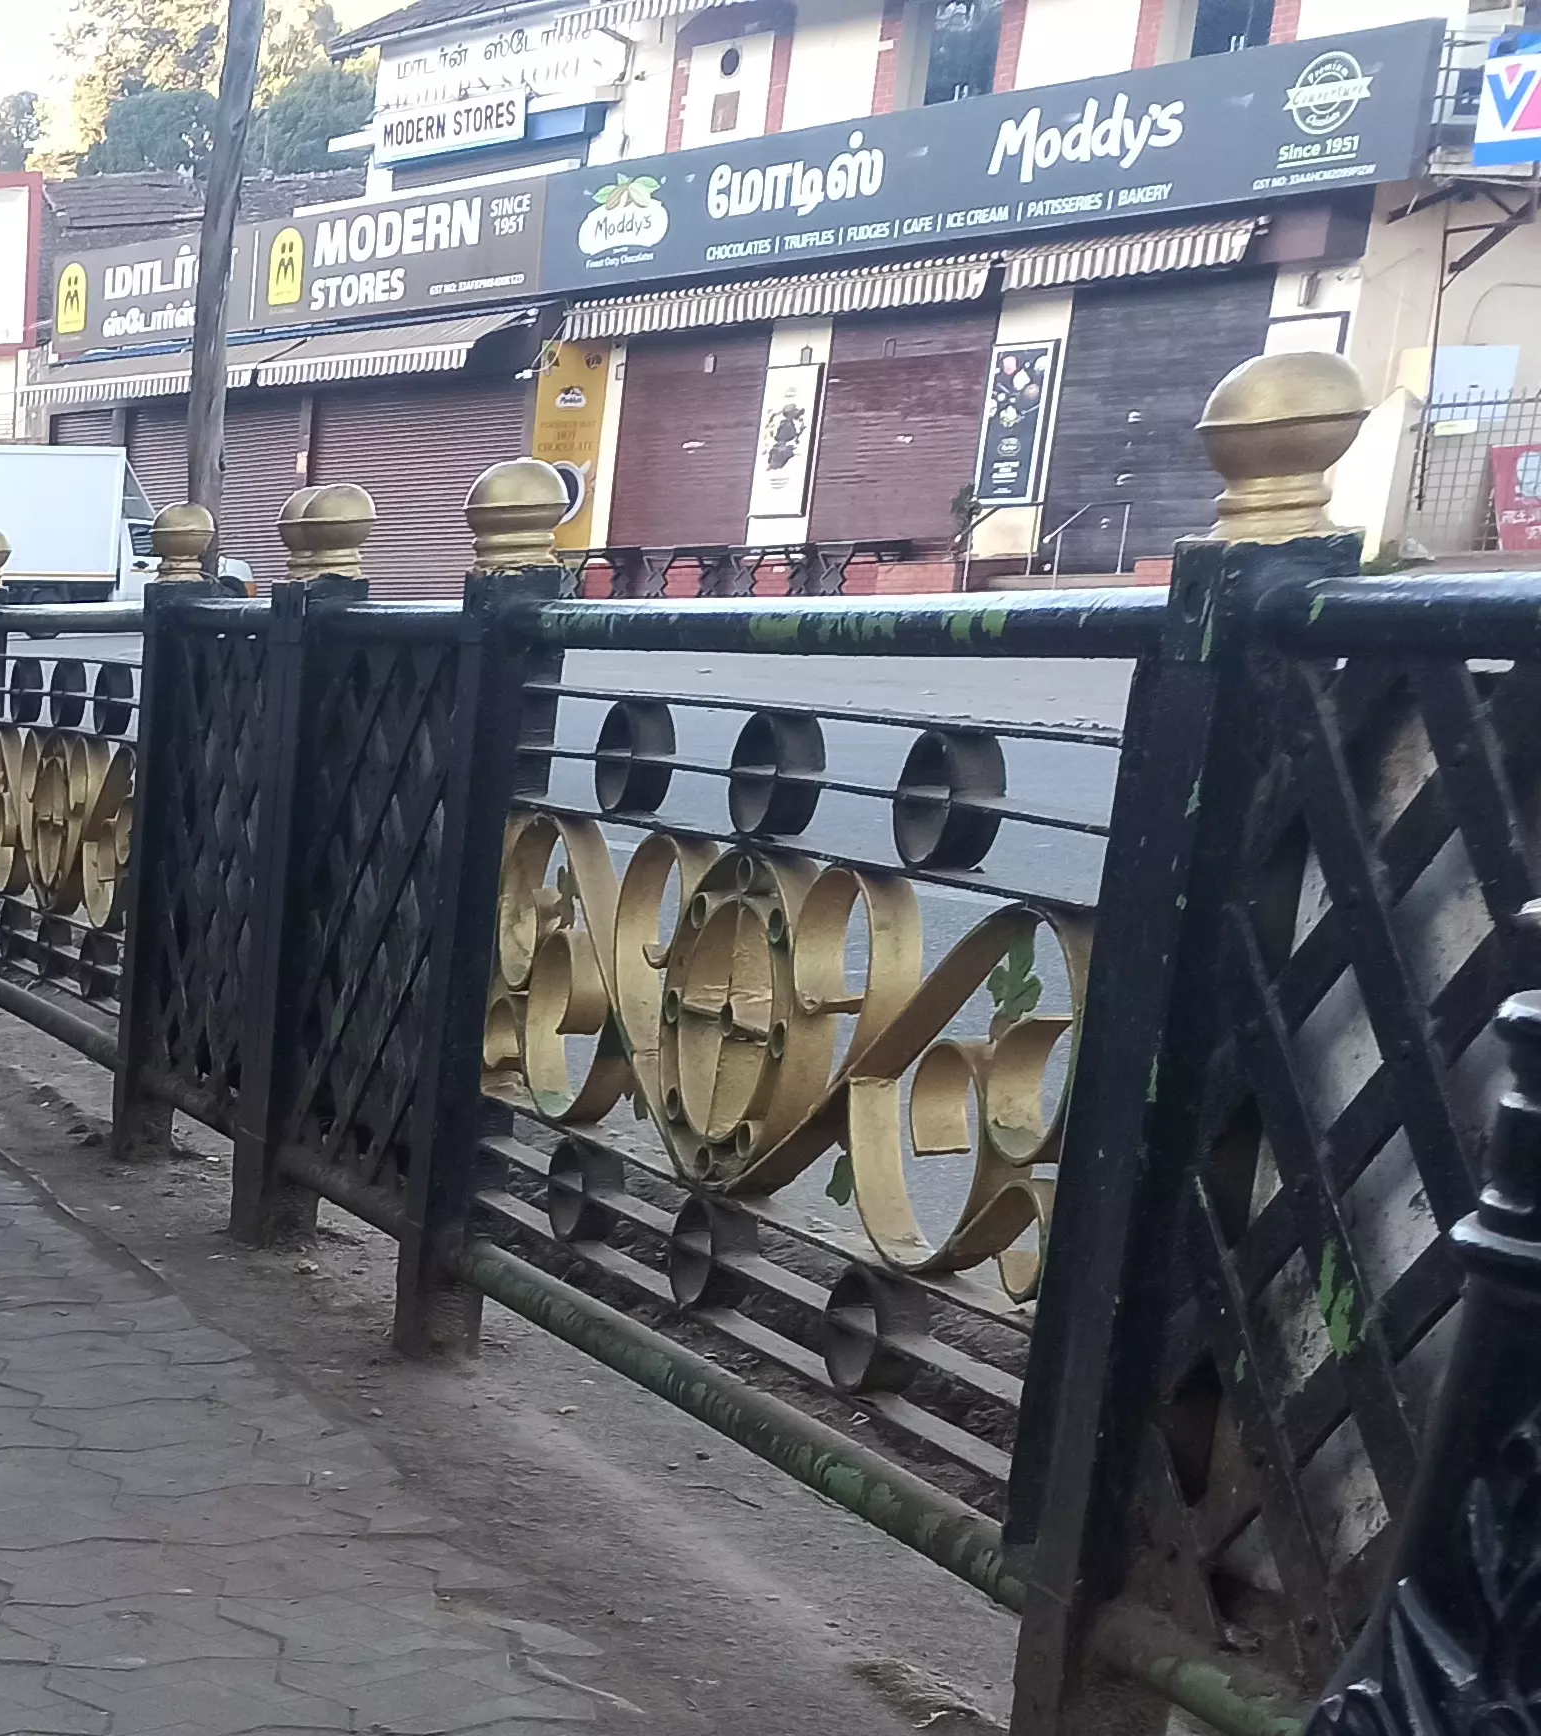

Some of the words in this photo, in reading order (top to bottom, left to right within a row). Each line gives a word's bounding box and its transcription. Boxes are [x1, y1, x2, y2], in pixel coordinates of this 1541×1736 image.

[384, 111, 446, 148] MODERN
[453, 100, 517, 136] STORES
[987, 92, 1185, 183] Moddy's
[1278, 143, 1321, 161] Since
[1325, 135, 1361, 154] 1951
[707, 131, 885, 219] மோடிஸ்
[489, 193, 532, 218] SINCE
[493, 214, 526, 237] 1951
[706, 238, 771, 261] CHOCOLATES
[783, 229, 835, 250] TRUFFLES
[846, 221, 890, 243] FUDGES
[903, 215, 933, 235] CAFE
[946, 211, 965, 228] ICE
[967, 205, 1009, 226] CREAM
[1026, 192, 1103, 218] PATISSERIES
[1118, 183, 1173, 206] BAKERY
[311, 196, 482, 268] MODERN
[309, 267, 406, 311] STORES
